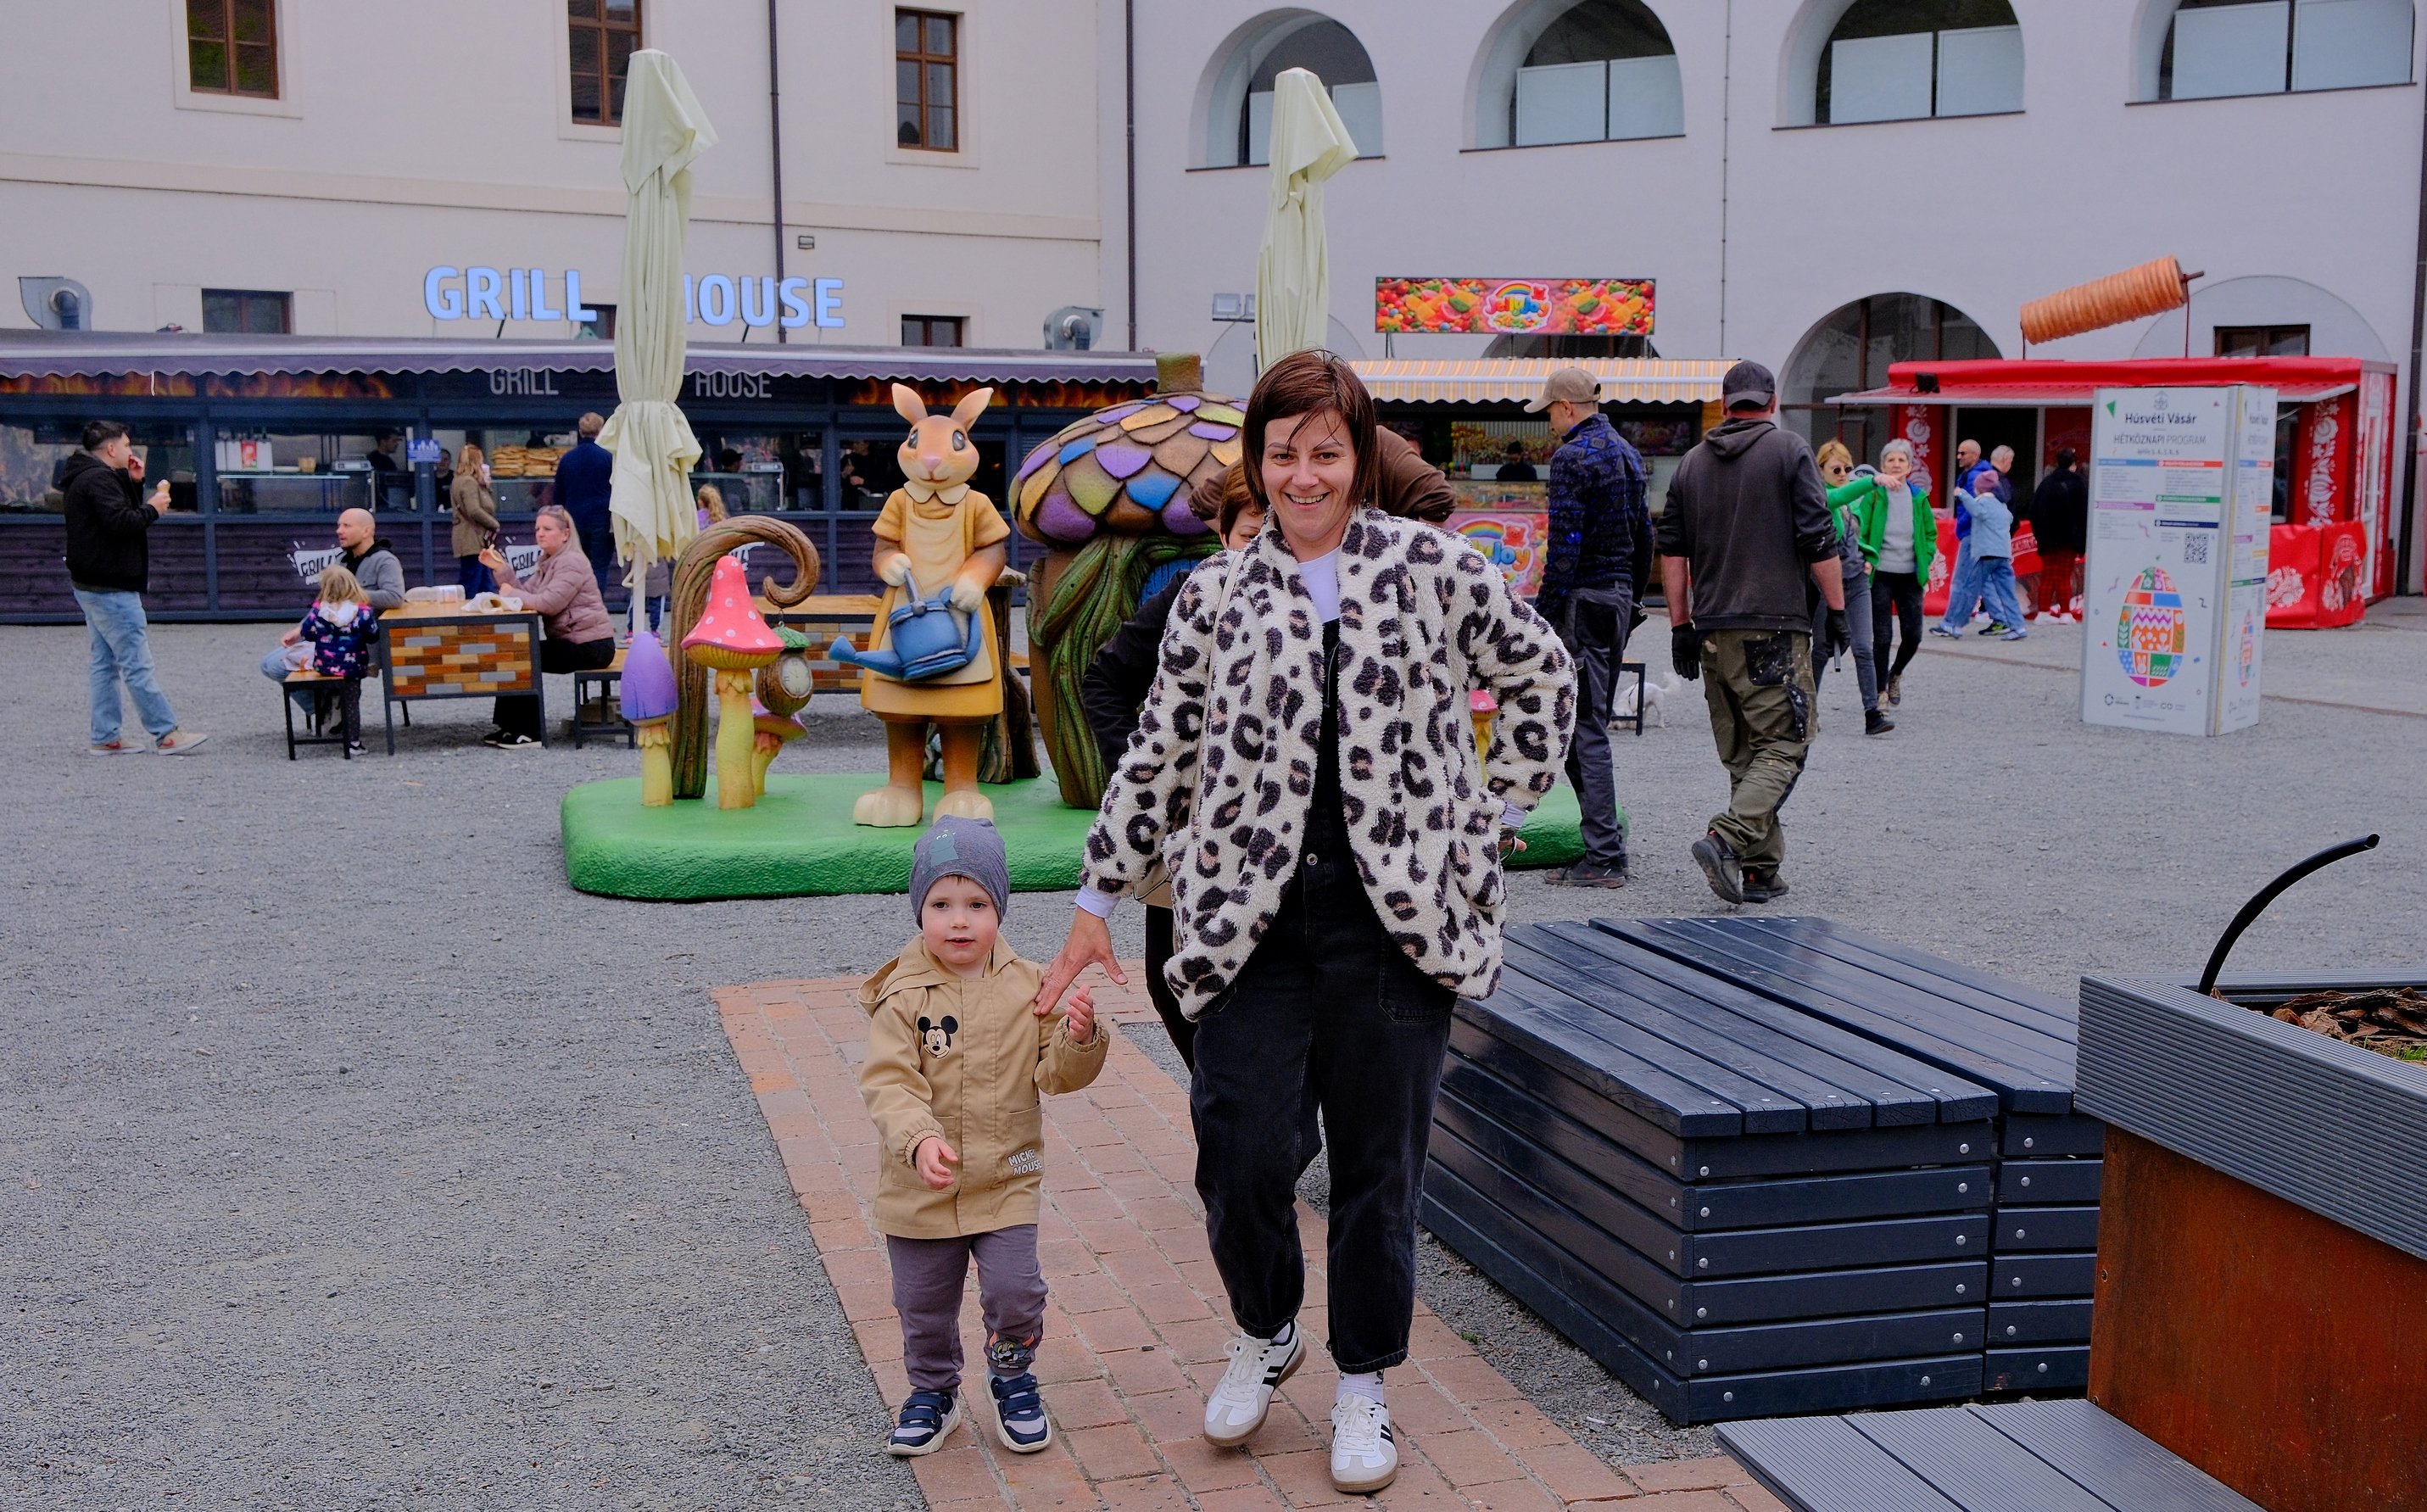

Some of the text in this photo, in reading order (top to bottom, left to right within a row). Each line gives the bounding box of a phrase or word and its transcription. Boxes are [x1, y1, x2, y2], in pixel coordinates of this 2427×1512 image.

[423, 265, 598, 322] GRILL
[490, 369, 773, 399] GRILL HOUSE
[2125, 413, 2198, 425] Húsvéti Vásár
[2167, 434, 2207, 446] PROGRAM
[511, 550, 542, 571] GRIL
